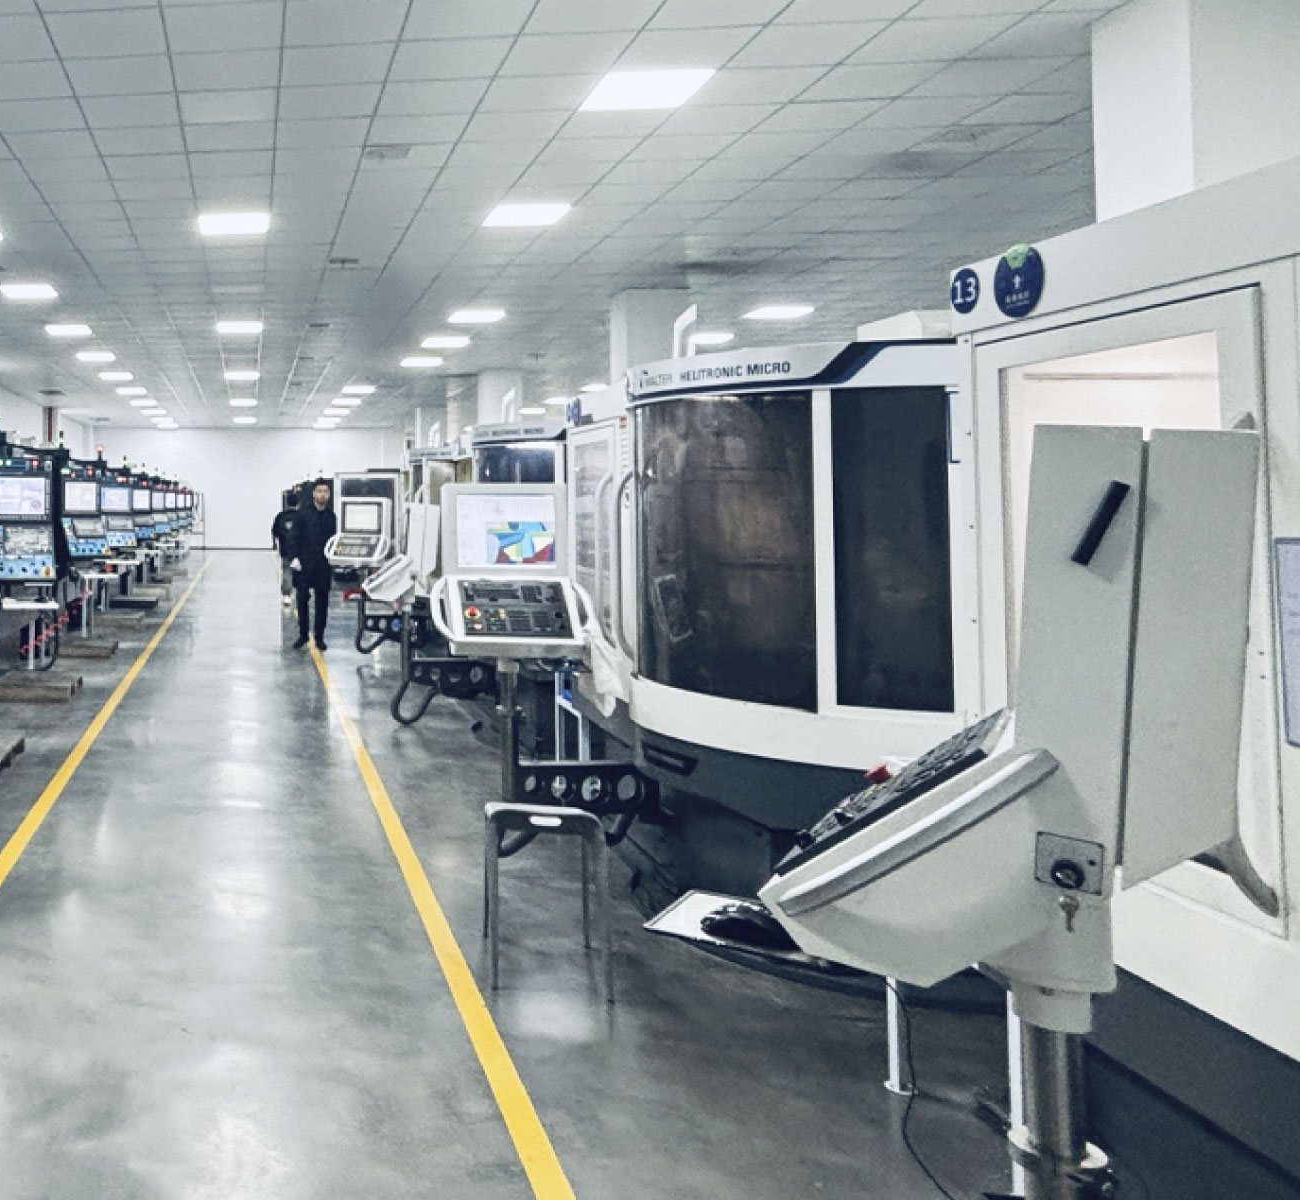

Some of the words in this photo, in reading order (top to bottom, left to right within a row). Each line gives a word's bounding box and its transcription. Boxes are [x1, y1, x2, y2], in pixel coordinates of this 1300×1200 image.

[952, 277, 977, 304] 13
[679, 365, 743, 383] HELITRONIC
[747, 361, 790, 376] MICRO
